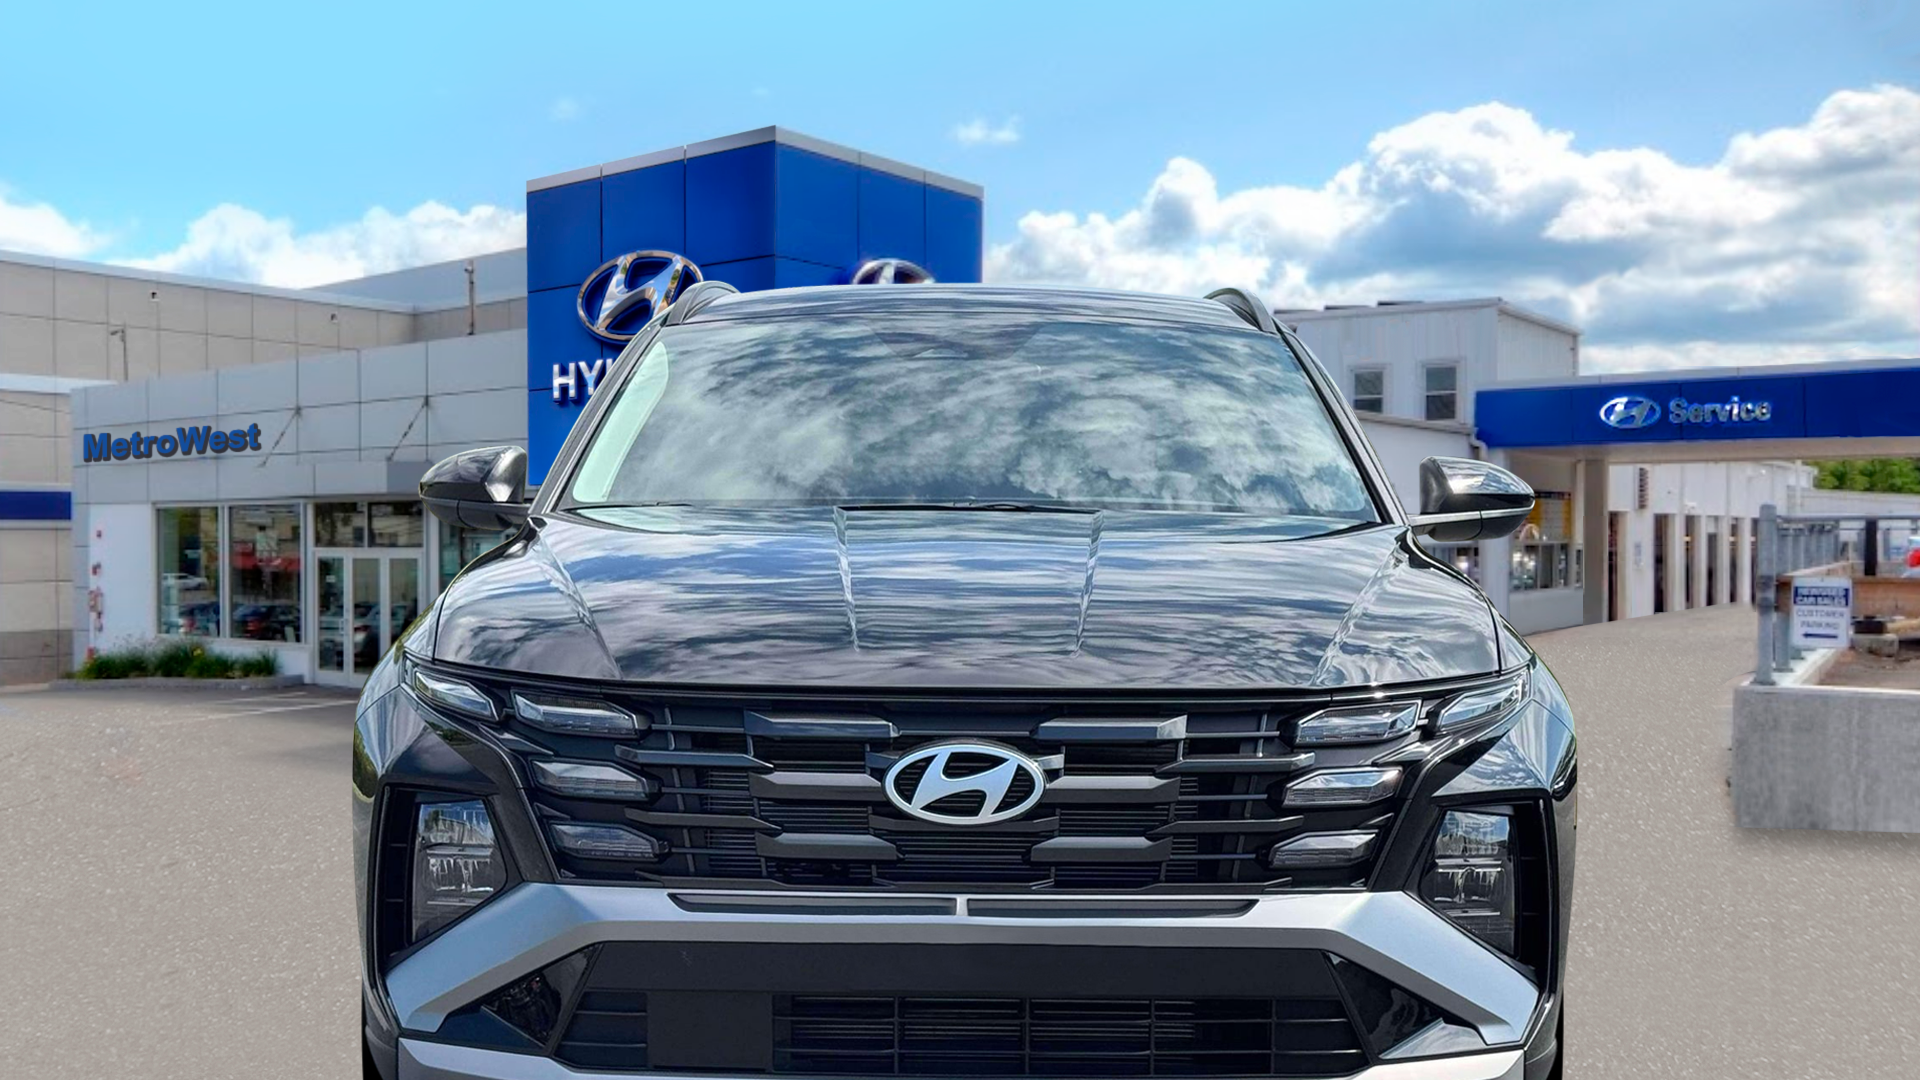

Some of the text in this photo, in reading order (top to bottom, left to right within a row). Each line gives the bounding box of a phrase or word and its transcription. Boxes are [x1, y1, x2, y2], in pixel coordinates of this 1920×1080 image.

[1668, 396, 1773, 424] Service
[83, 422, 262, 463] MetroWest
[1795, 596, 1846, 607] CAR SALES
[1796, 608, 1845, 618] CUSTOMER
[1800, 620, 1840, 630] PARKING
